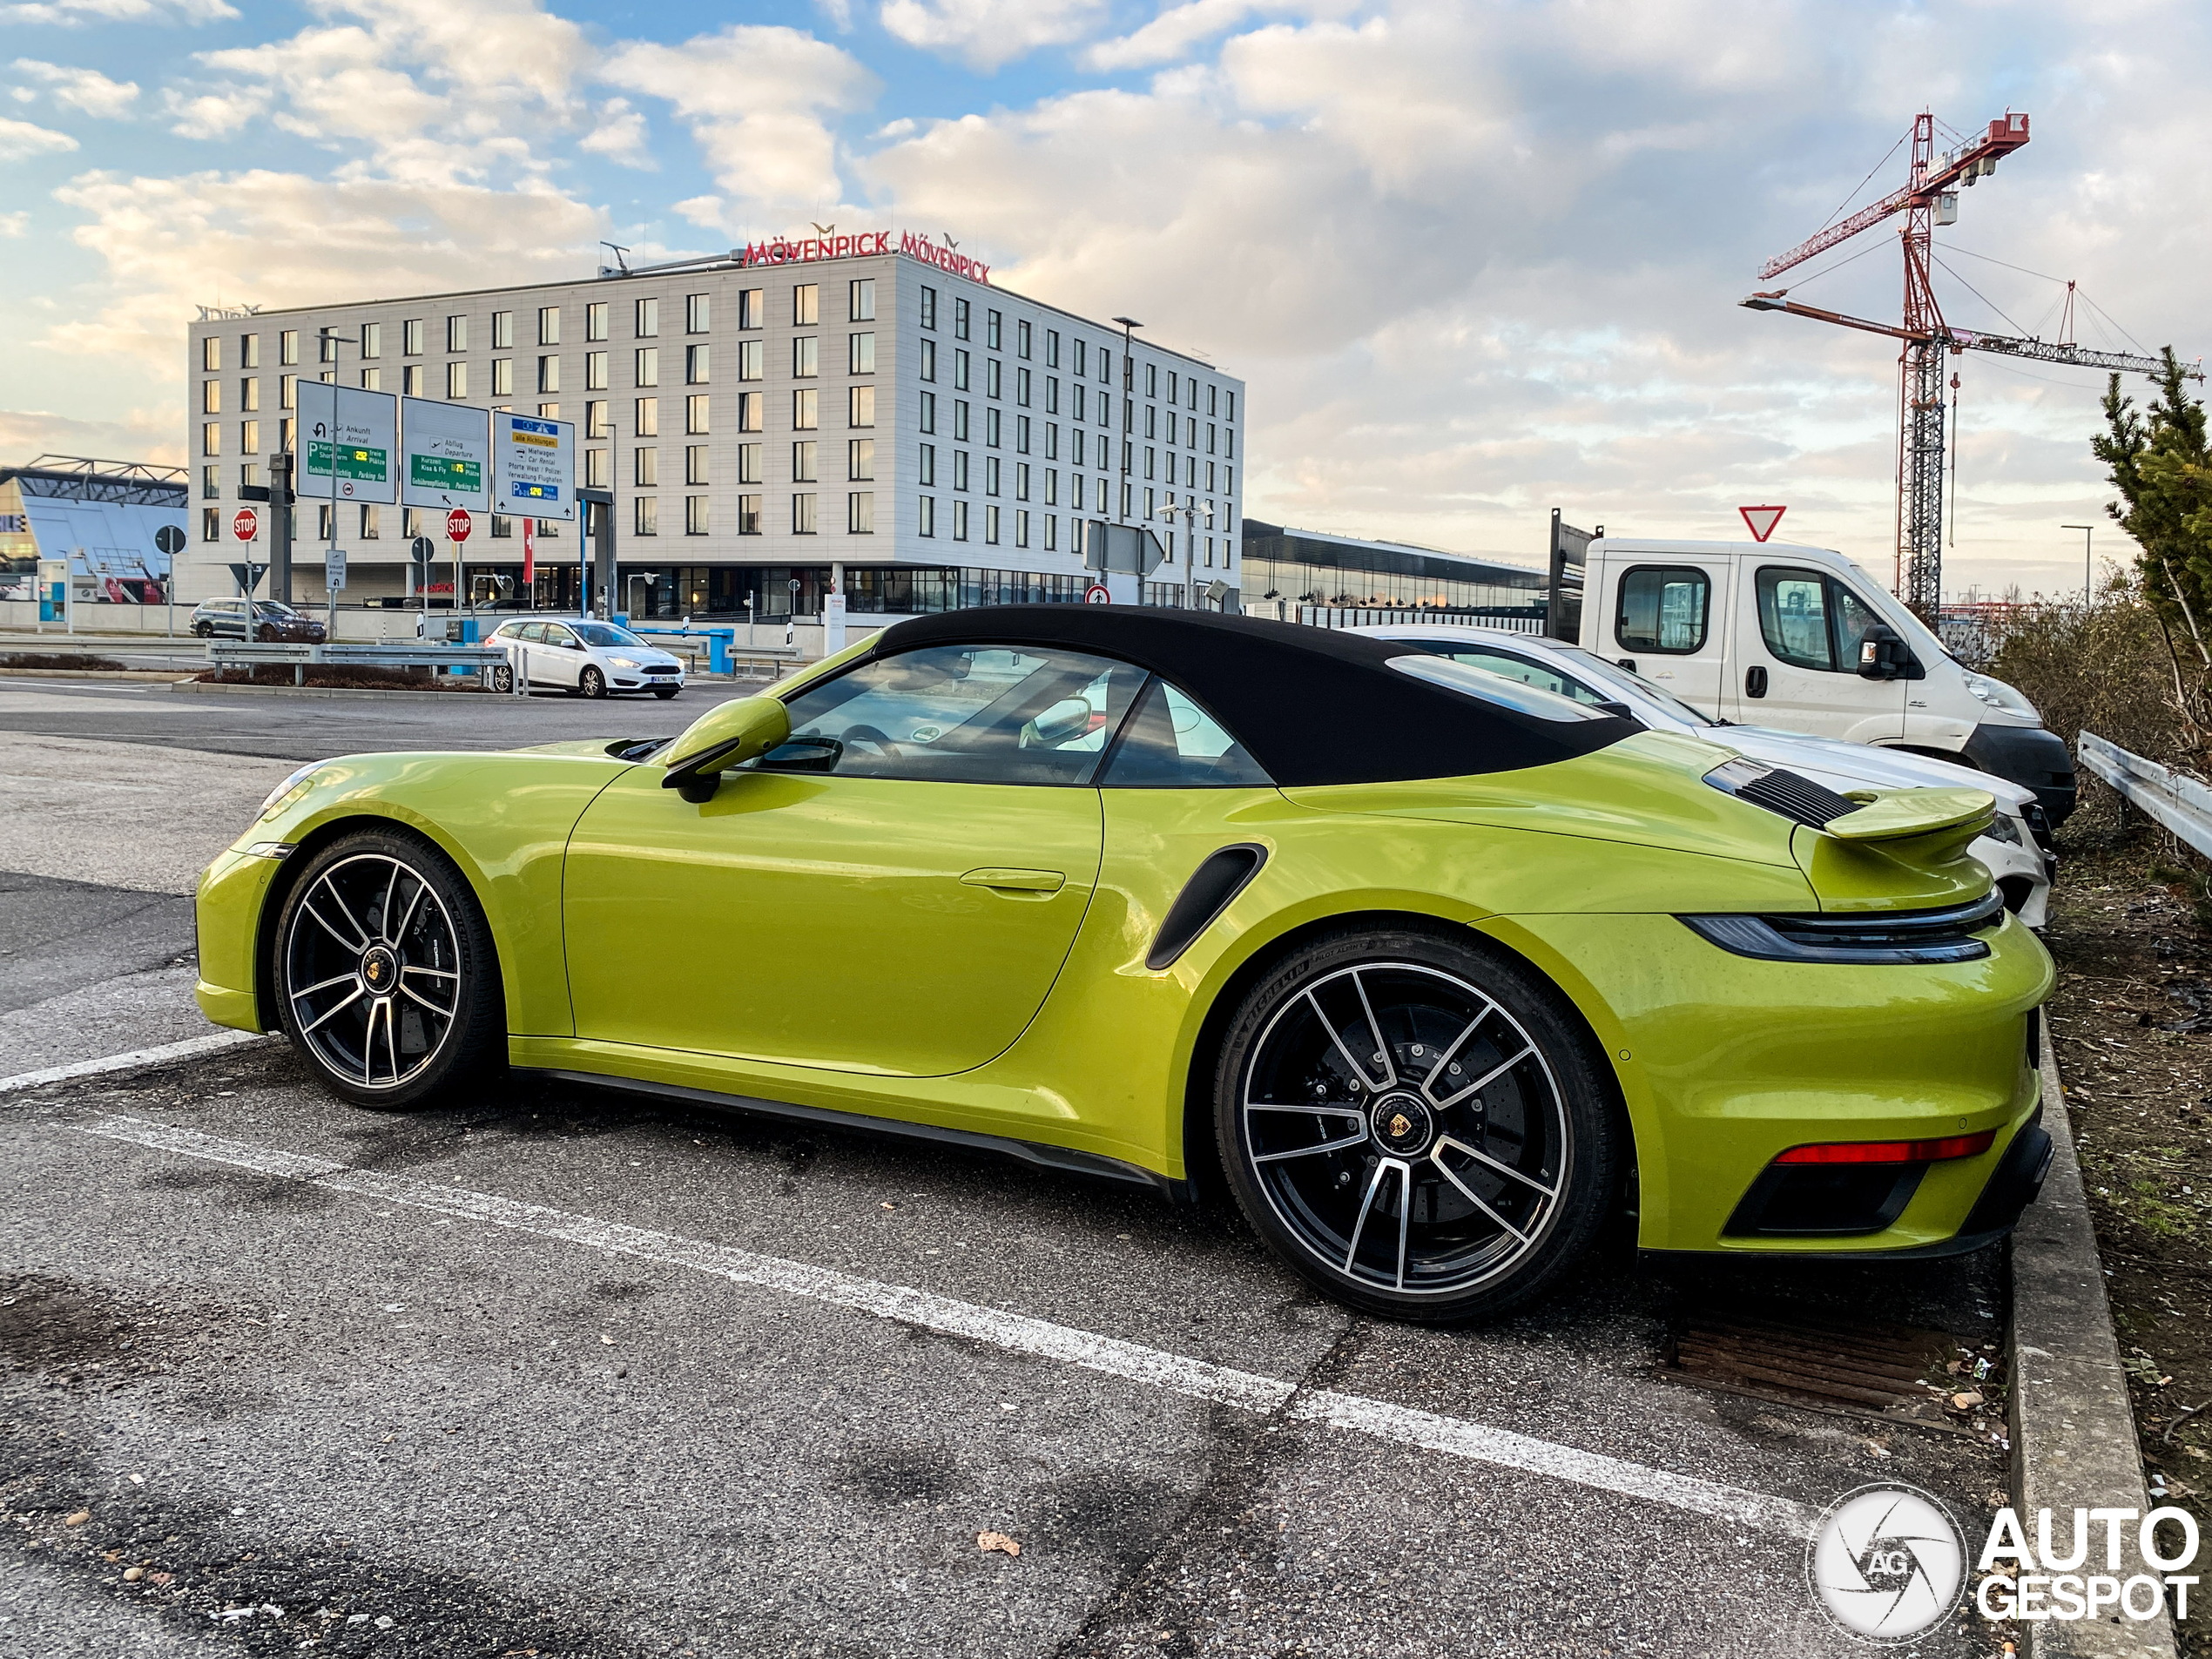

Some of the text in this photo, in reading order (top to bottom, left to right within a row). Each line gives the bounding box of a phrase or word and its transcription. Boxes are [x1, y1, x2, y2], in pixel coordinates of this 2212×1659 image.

[742, 231, 891, 268] MÖVENPICK
[900, 228, 992, 287] MÖVENPICK
[346, 425, 371, 435] Ankunft
[346, 435, 369, 444] Arrival
[445, 440, 463, 449] Abflug
[526, 435, 555, 446] Richtungen
[308, 442, 318, 457] P
[319, 443, 342, 452] Kurzit
[445, 448, 473, 458] Departure
[528, 448, 555, 457] Mietwagen
[308, 466, 352, 479] Gebührenlichtig
[508, 471, 563, 483] Verwaltung Flughafen
[234, 517, 255, 532] STOP
[448, 518, 470, 533] STOP
[1314, 950, 1334, 962] PILOT
[1336, 943, 1359, 954] ALPIN
[1244, 961, 1308, 1029] MICHELIN
